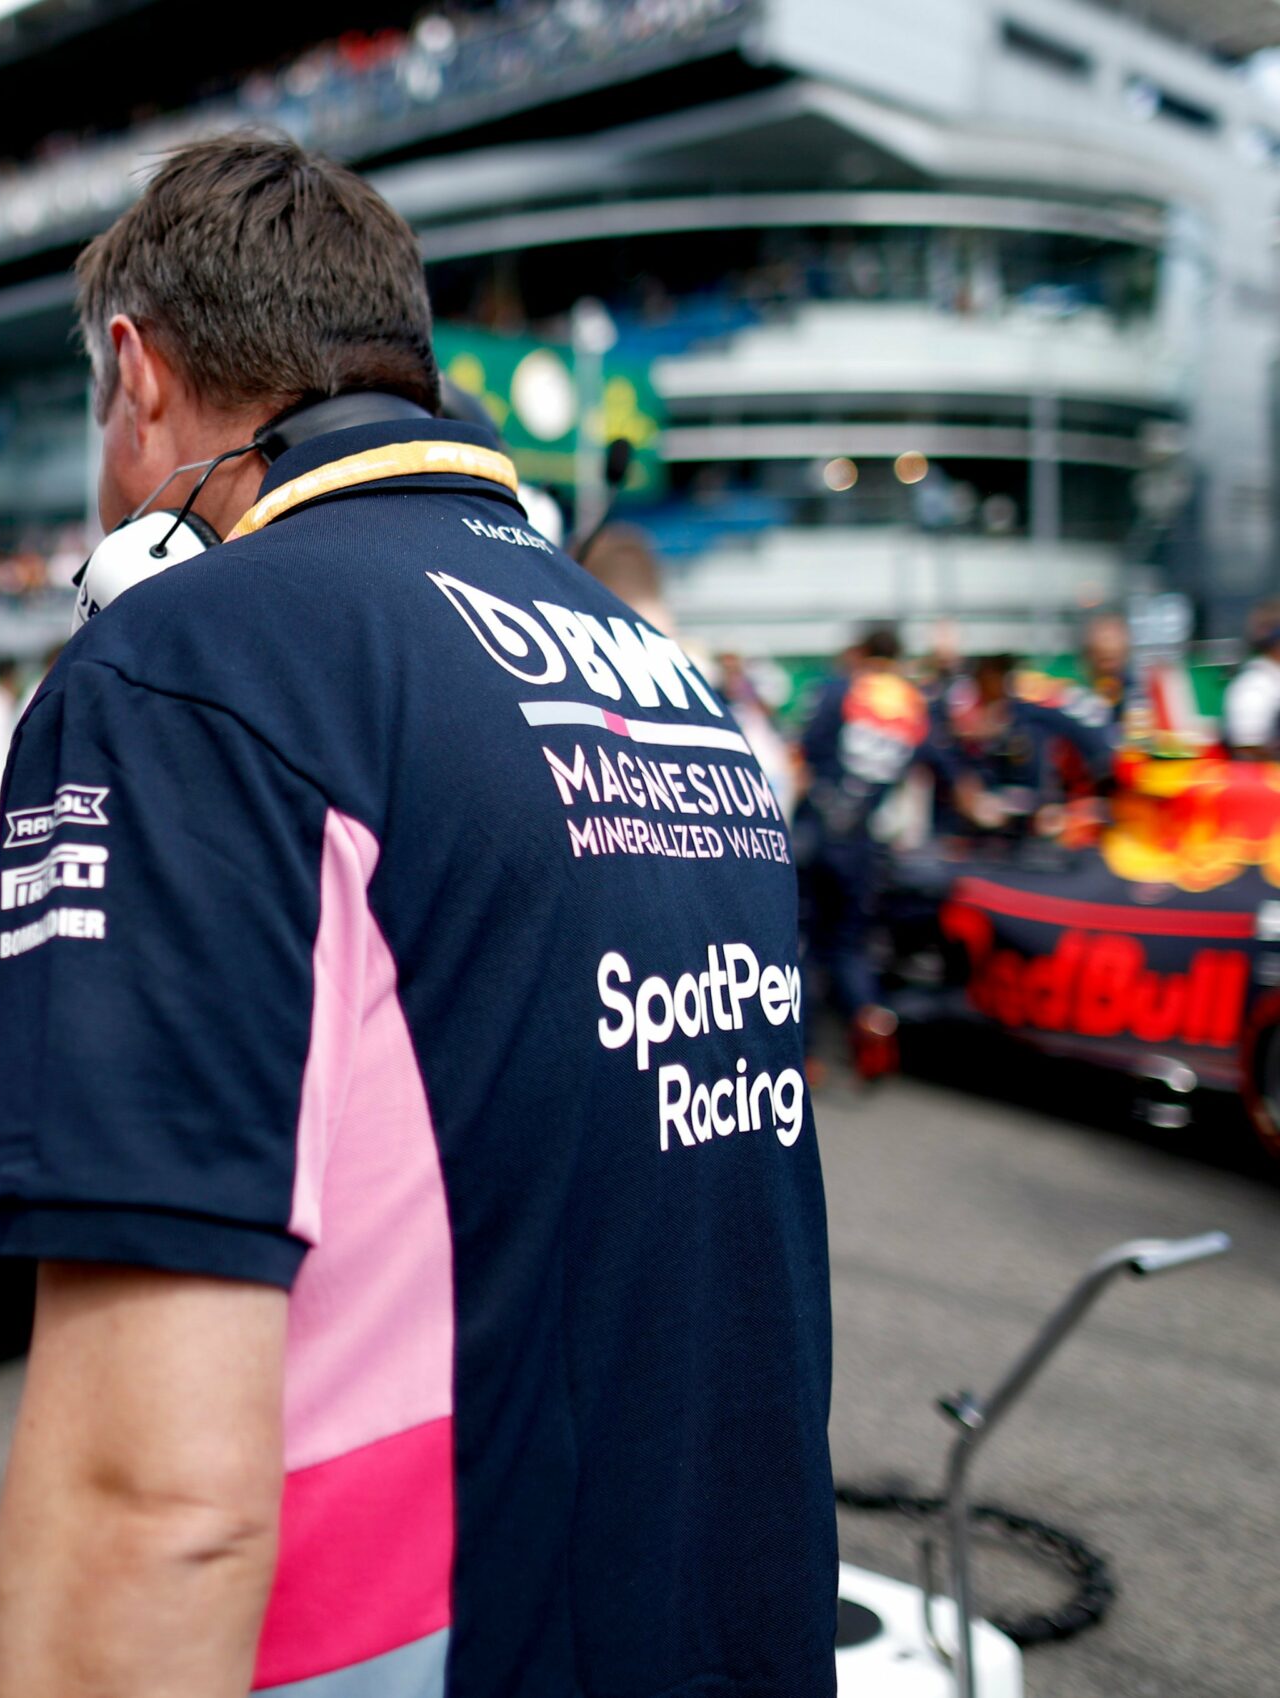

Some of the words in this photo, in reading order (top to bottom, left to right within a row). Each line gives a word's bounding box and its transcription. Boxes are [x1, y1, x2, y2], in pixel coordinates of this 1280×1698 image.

[533, 600, 724, 718] BWT
[542, 744, 781, 821] MAGNESIUM
[567, 816, 723, 858] MINERALIZED
[723, 826, 791, 864] WATER
[658, 1057, 804, 1152] Racing
